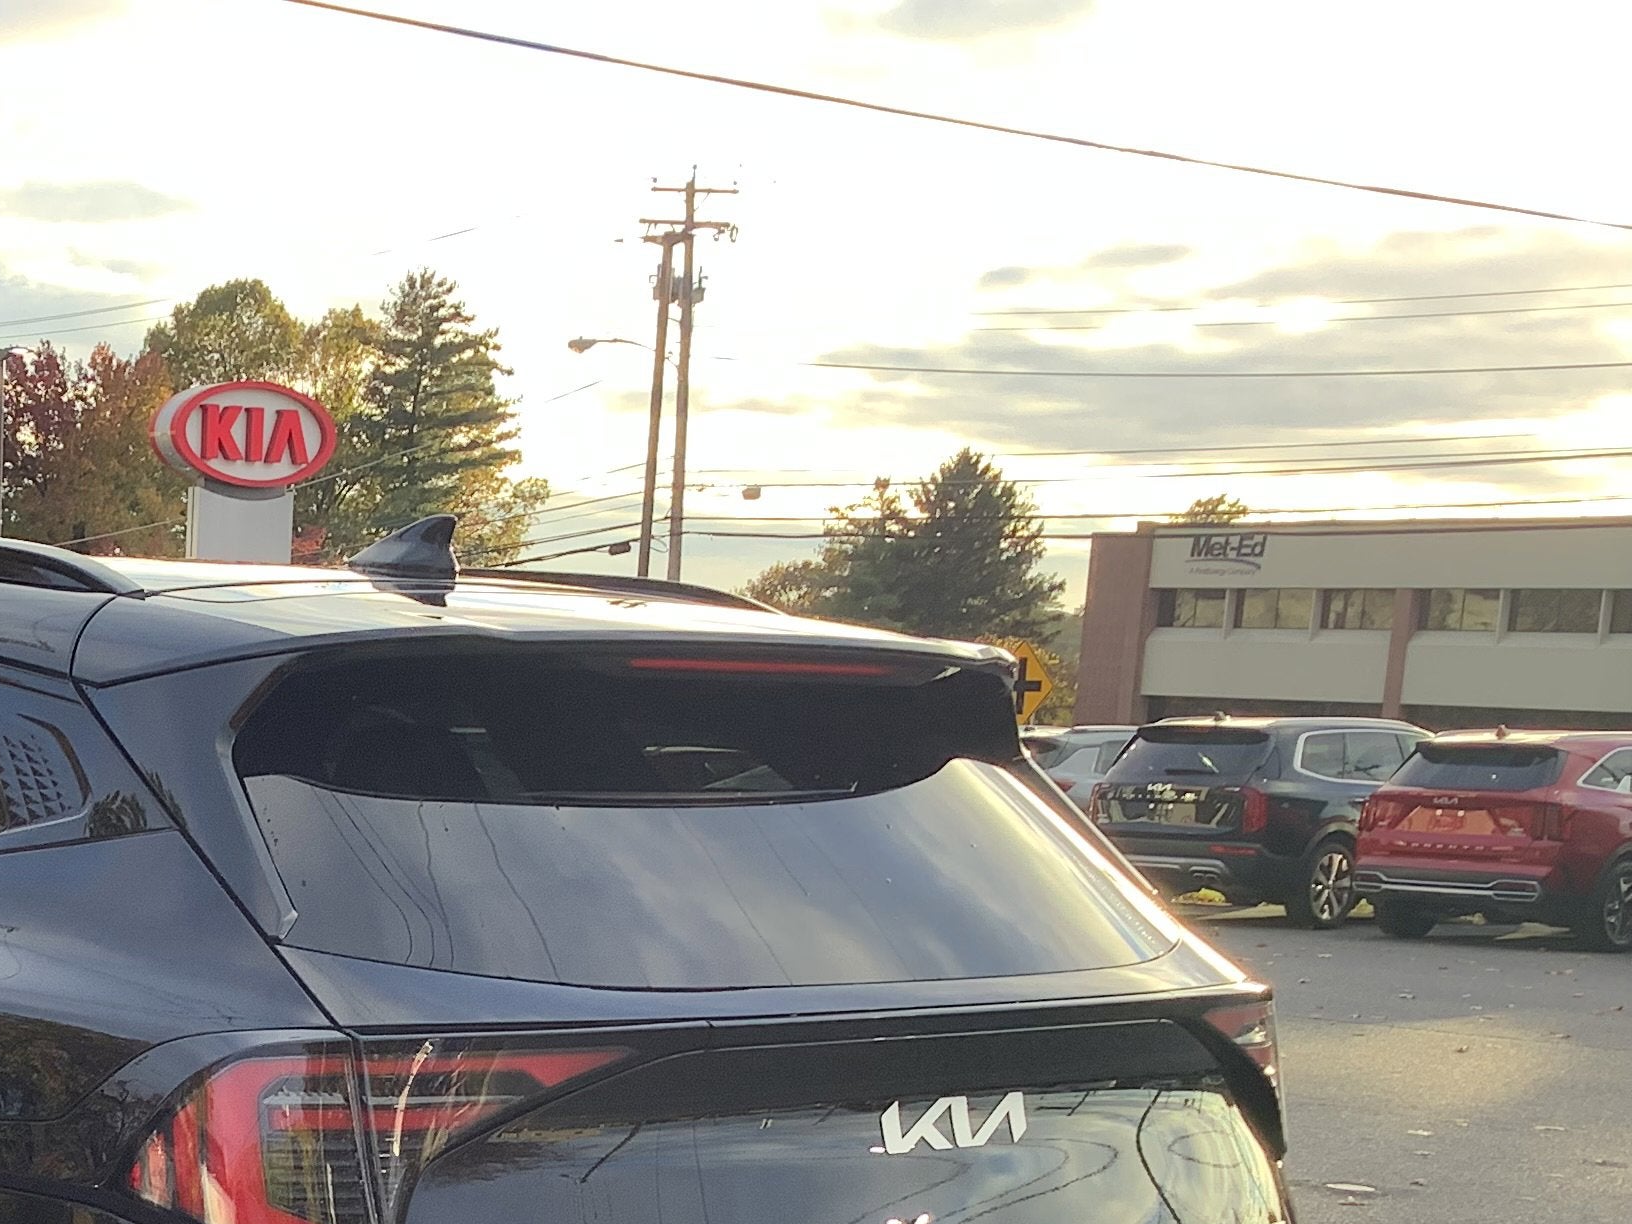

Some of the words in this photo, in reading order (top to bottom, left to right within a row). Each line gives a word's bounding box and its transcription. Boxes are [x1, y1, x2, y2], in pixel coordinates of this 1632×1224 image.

[200, 404, 309, 466] KIA
[1190, 534, 1268, 557] Met-Ed
[880, 1091, 1028, 1155] KIA
